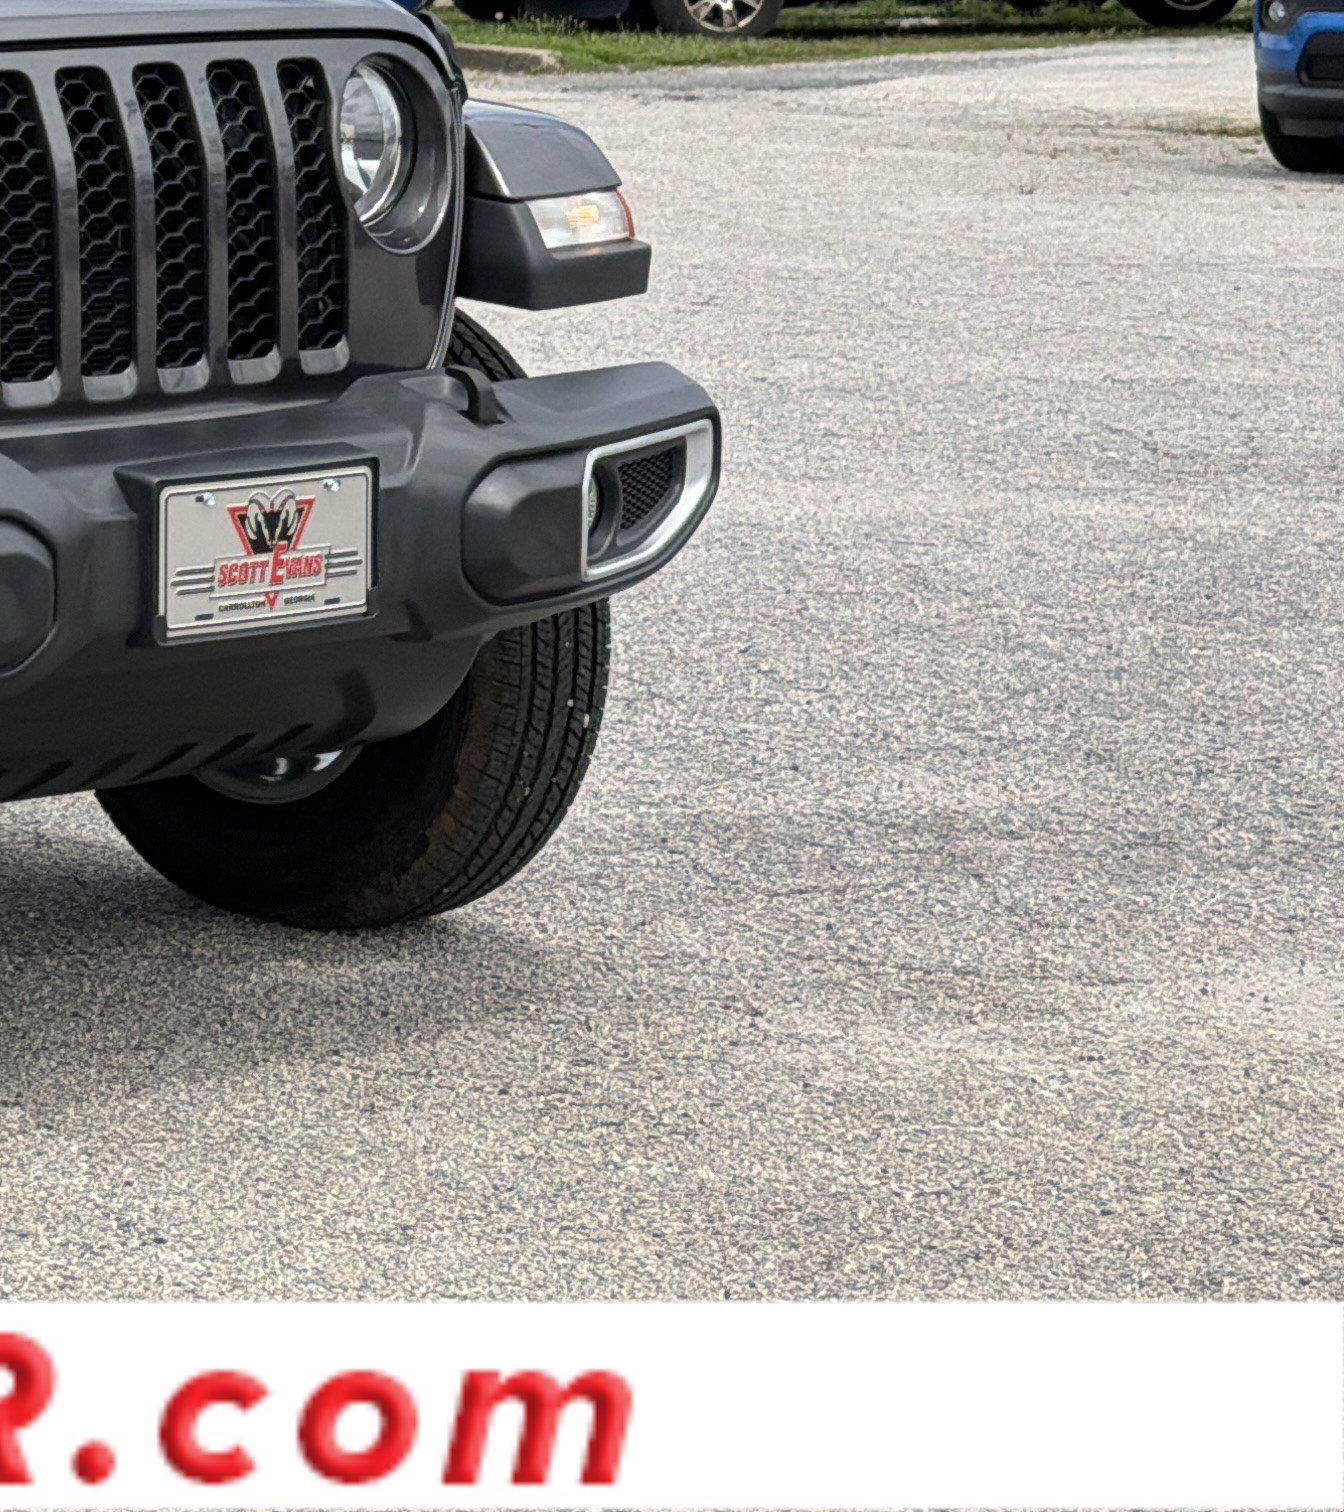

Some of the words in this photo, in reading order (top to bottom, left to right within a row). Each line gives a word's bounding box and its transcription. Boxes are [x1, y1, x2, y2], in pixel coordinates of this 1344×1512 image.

[218, 560, 269, 587] SCOTT
[270, 542, 323, 585] EVANS
[219, 600, 266, 612] CARROLLTON
[284, 594, 315, 605] GEORGIA
